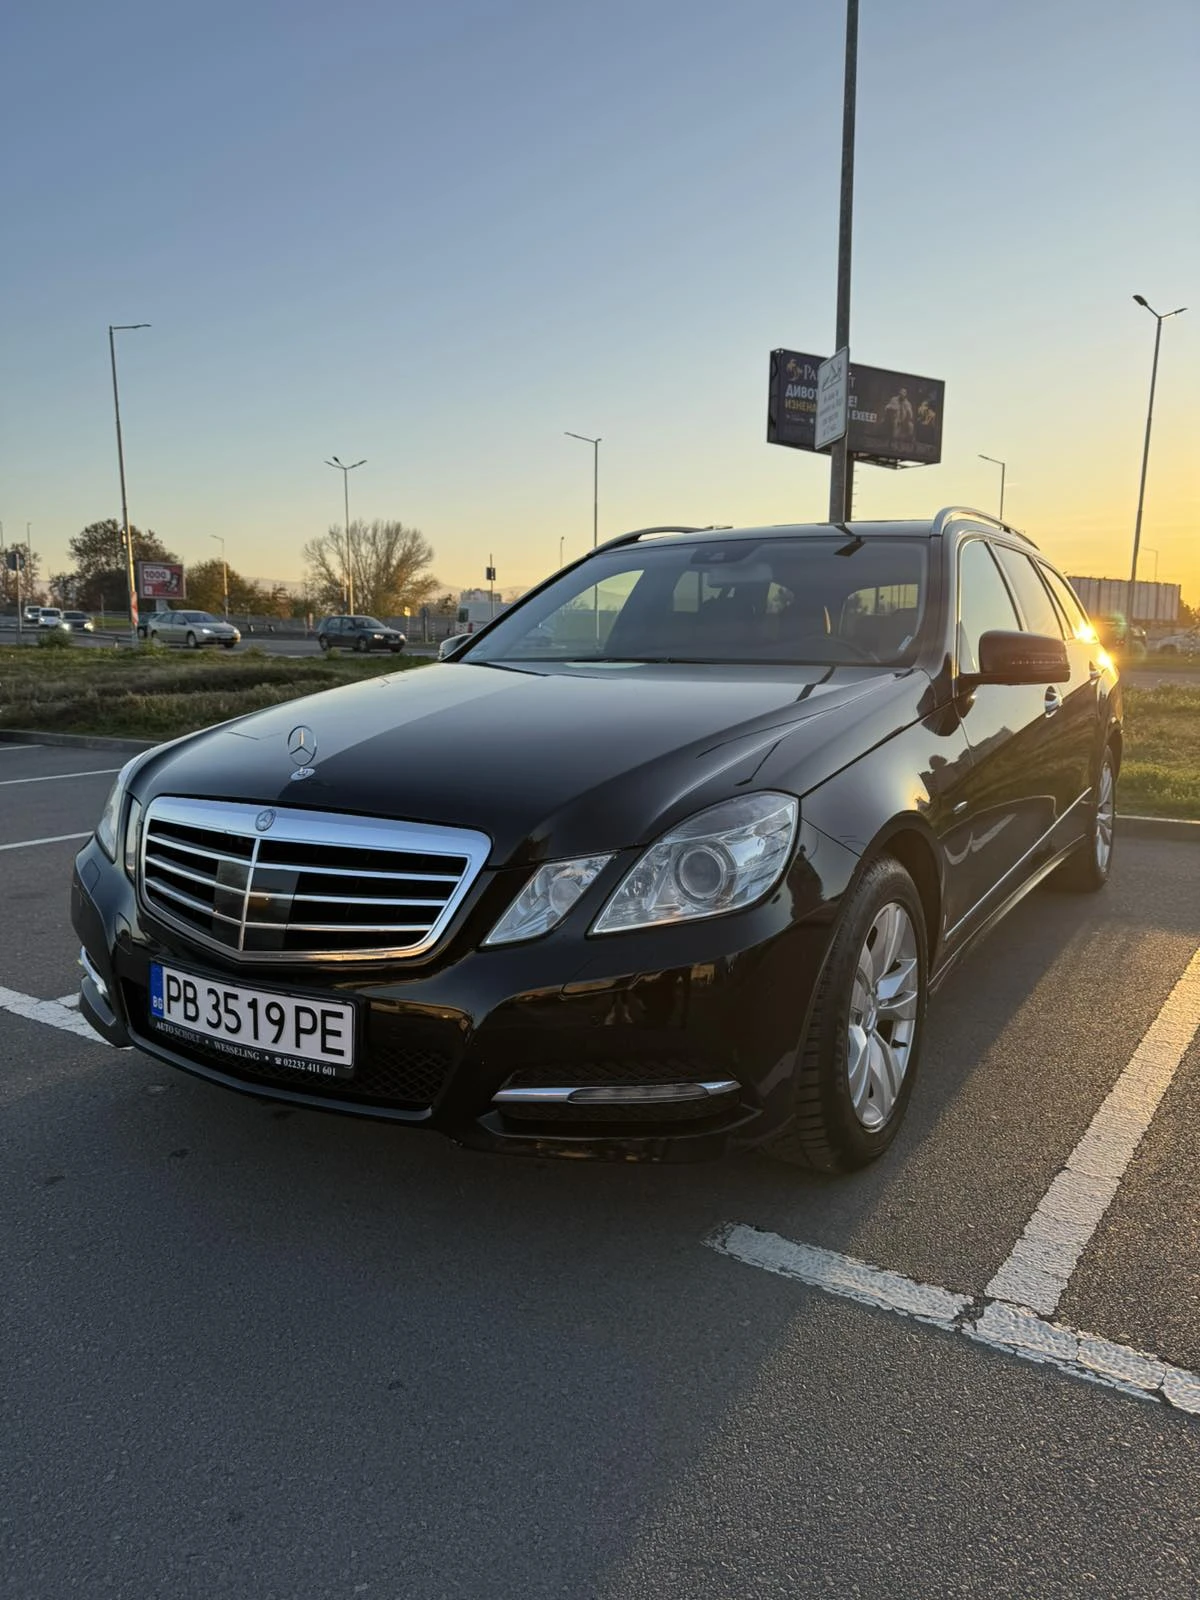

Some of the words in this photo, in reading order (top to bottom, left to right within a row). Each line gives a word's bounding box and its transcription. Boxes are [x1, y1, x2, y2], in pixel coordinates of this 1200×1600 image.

[153, 995, 163, 1010] BG
[214, 1041, 260, 1061] WESSELING
[283, 1058, 306, 1070] 02232
[307, 1063, 320, 1073] 411
[322, 1065, 336, 1077] 601
